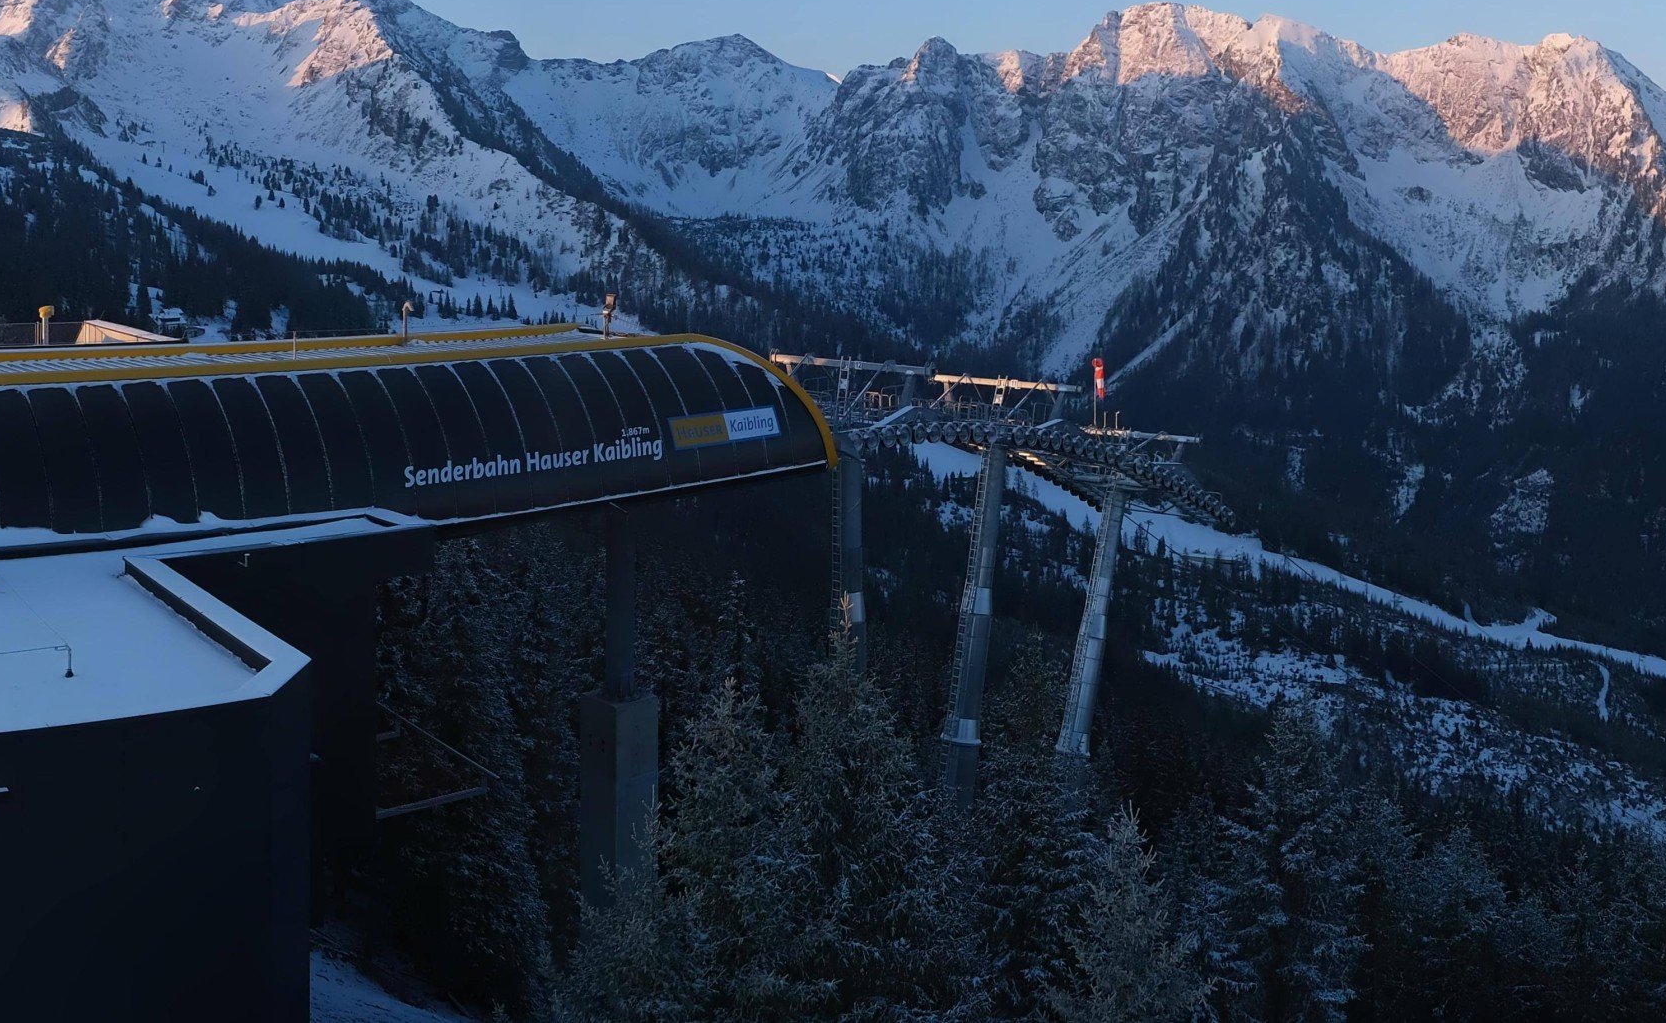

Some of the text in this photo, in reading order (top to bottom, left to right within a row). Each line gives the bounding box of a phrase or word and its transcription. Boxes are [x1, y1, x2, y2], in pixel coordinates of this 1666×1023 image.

[729, 415, 774, 432] Kaibling
[404, 437, 663, 487] Senderbahn Hauser Kaibling
